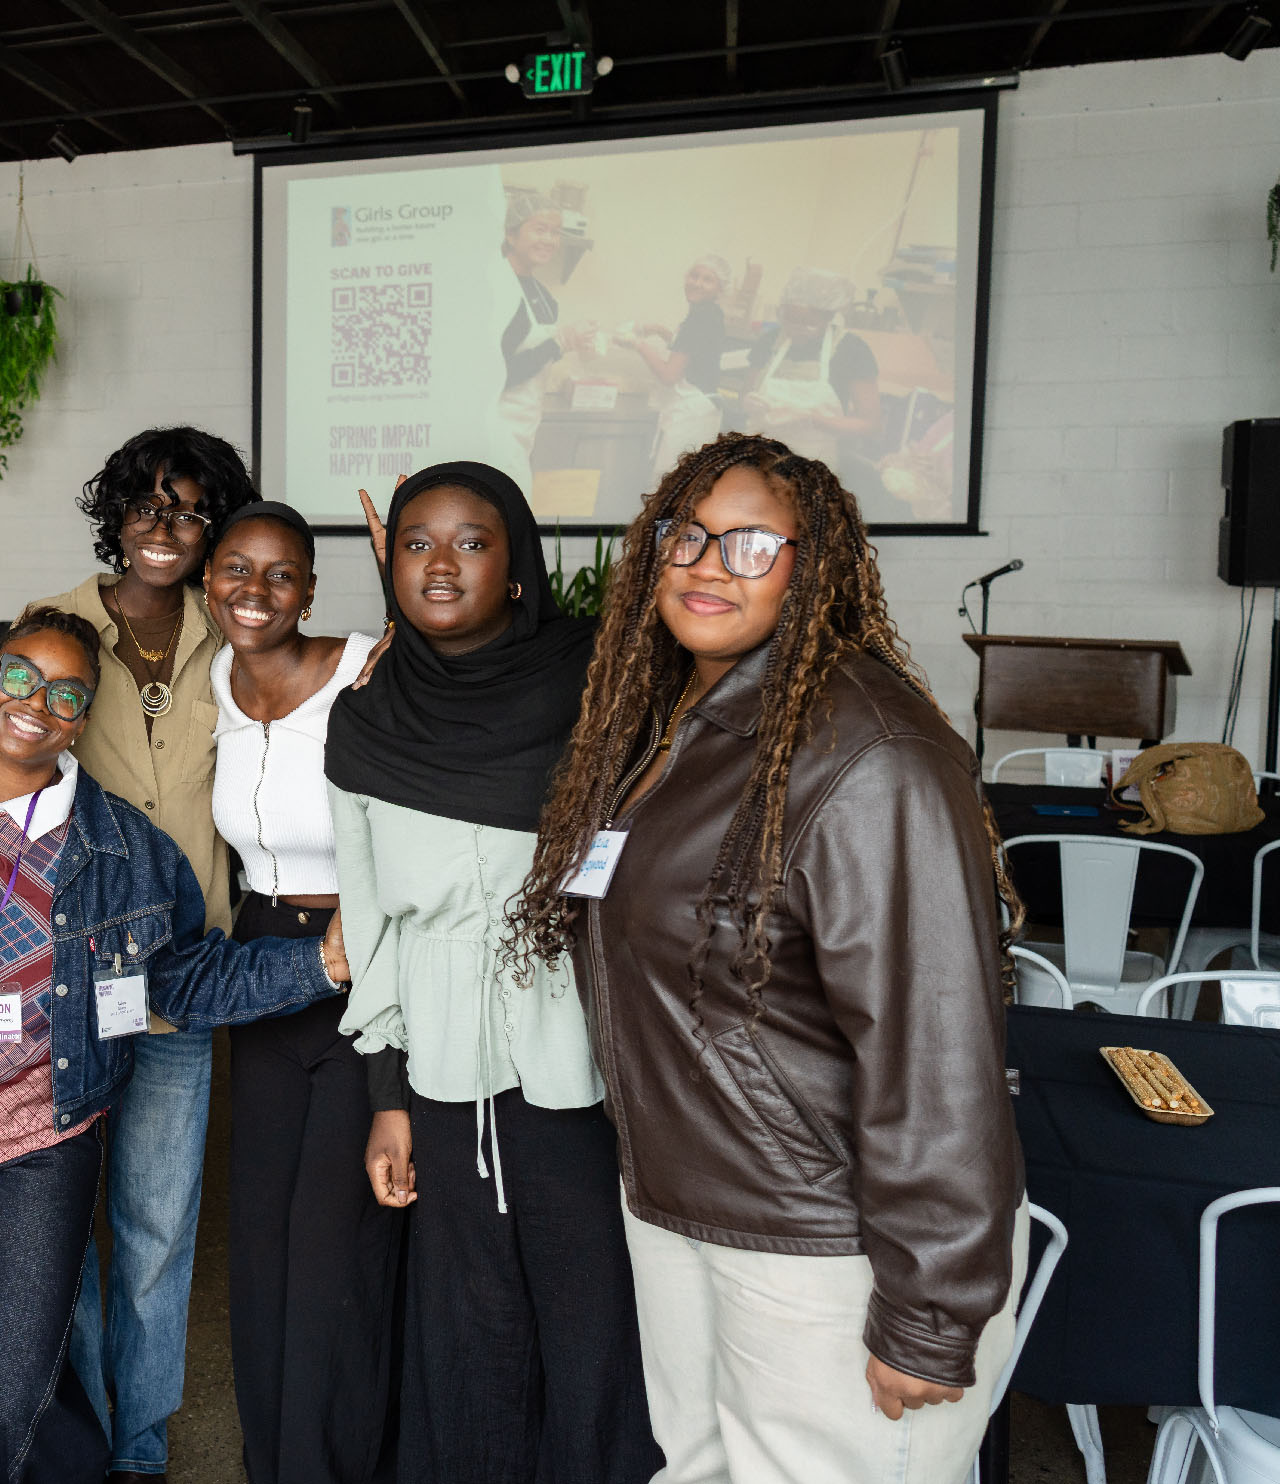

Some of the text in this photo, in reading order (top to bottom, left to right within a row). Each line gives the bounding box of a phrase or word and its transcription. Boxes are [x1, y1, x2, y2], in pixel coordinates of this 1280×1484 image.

[535, 51, 586, 92] EXIT
[355, 204, 453, 222] Girls Group
[330, 262, 432, 280] SCAN TO GIVE
[330, 424, 432, 449] SPRING IMPACT
[330, 452, 413, 477] HAPPY HOUR
